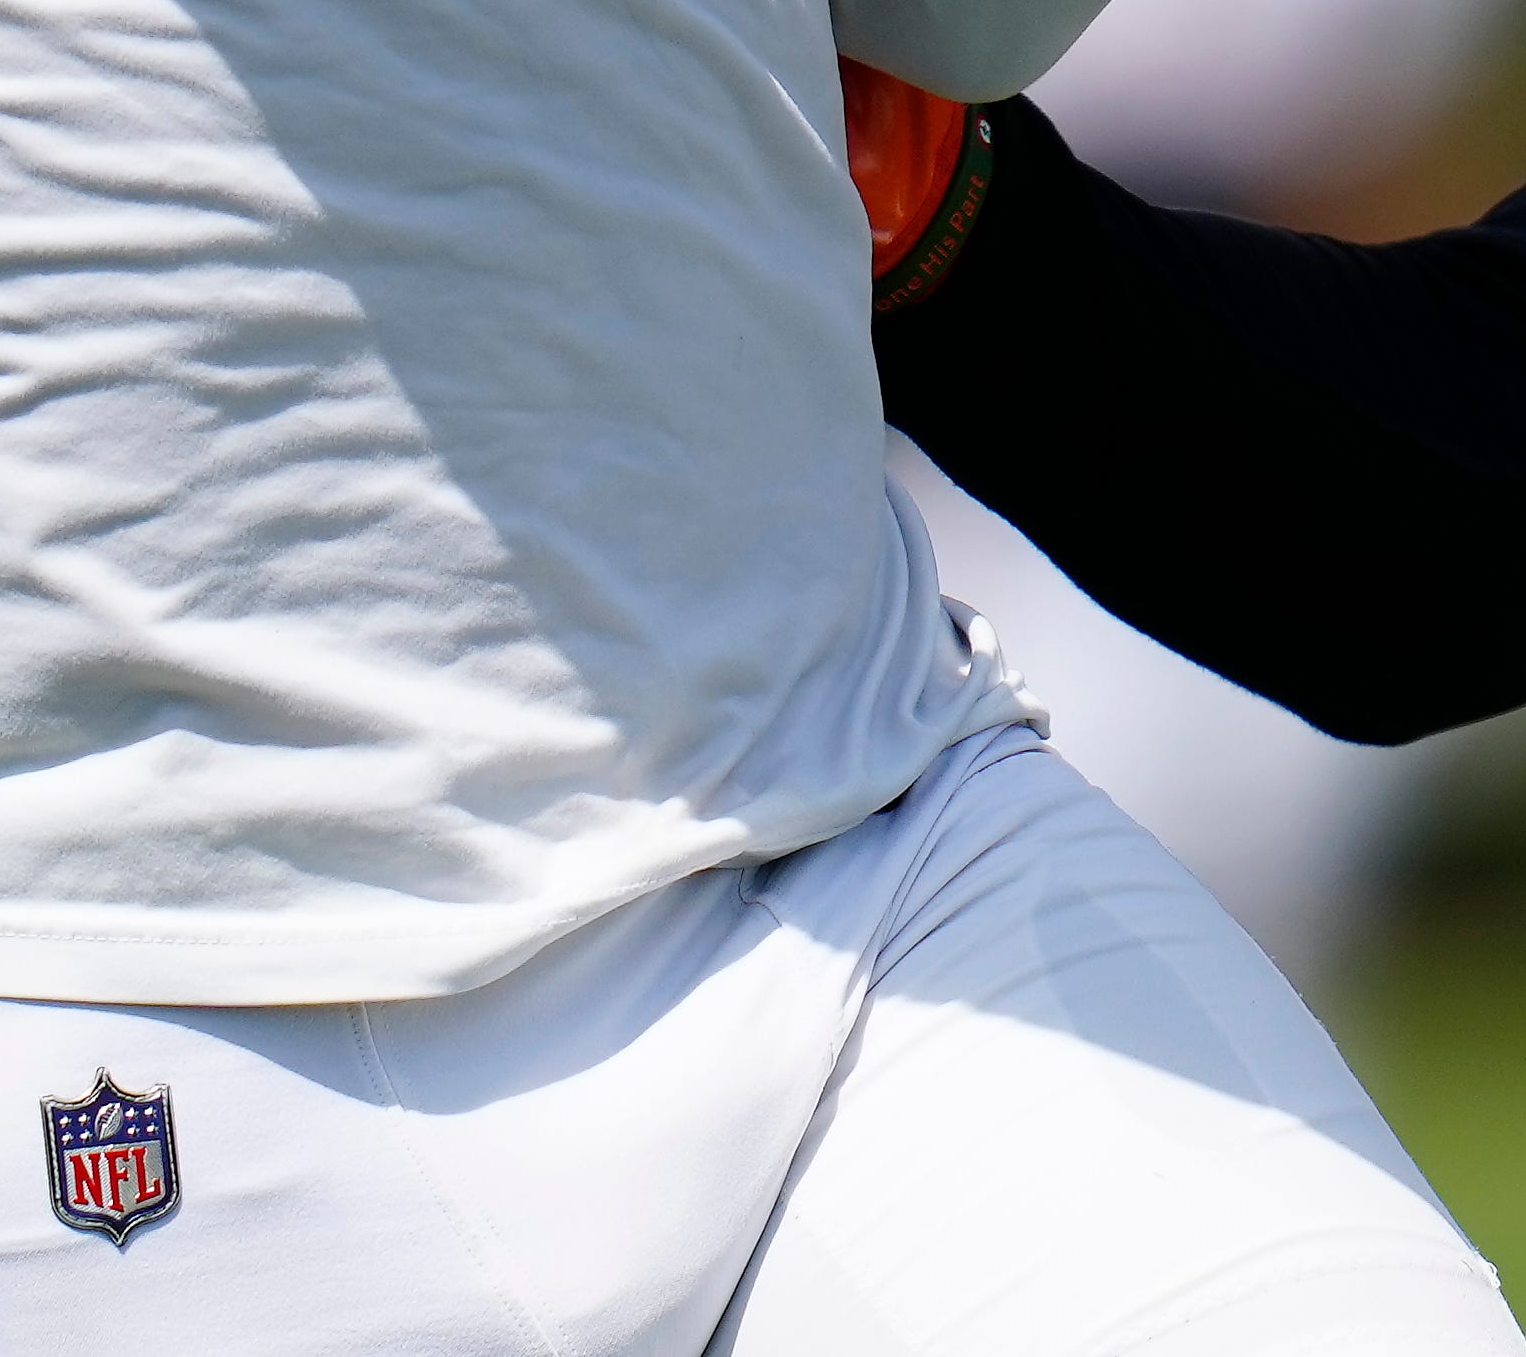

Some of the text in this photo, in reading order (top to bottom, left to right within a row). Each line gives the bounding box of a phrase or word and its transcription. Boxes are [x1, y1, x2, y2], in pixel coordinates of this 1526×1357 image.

[921, 235, 957, 276] His
[949, 174, 985, 232] Part
[70, 1146, 162, 1213] NFL
